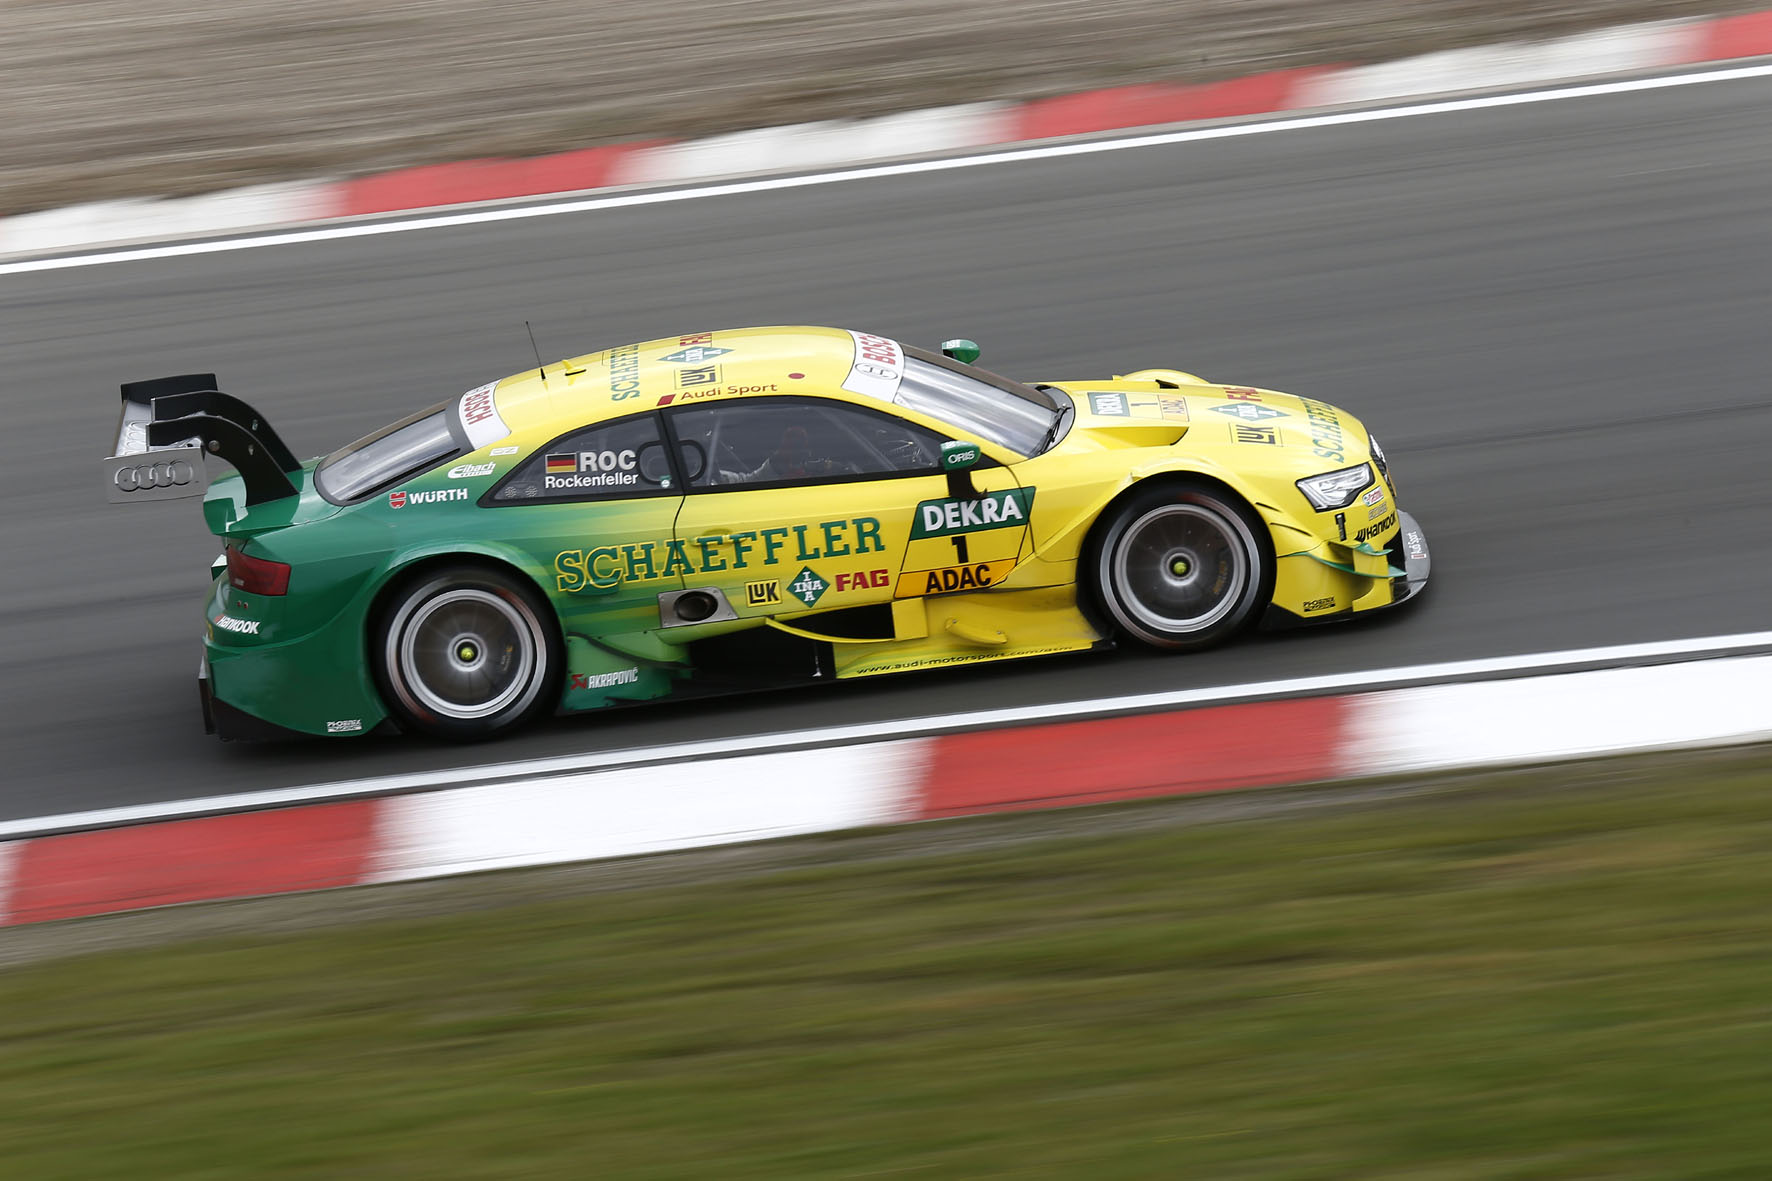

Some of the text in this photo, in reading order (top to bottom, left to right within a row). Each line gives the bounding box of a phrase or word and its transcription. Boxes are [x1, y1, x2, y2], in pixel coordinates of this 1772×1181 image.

[680, 383, 778, 400] Audi Sport
[448, 462, 496, 478] Eibach
[580, 449, 637, 472] ROC
[545, 472, 639, 489] Rockenfeller
[409, 488, 468, 504] WÜRTH
[922, 494, 1023, 532] DEKRA
[555, 516, 887, 592] SCHAEFFLER
[951, 535, 969, 564] 1
[835, 569, 890, 592] FAG
[926, 564, 992, 593] ADAC
